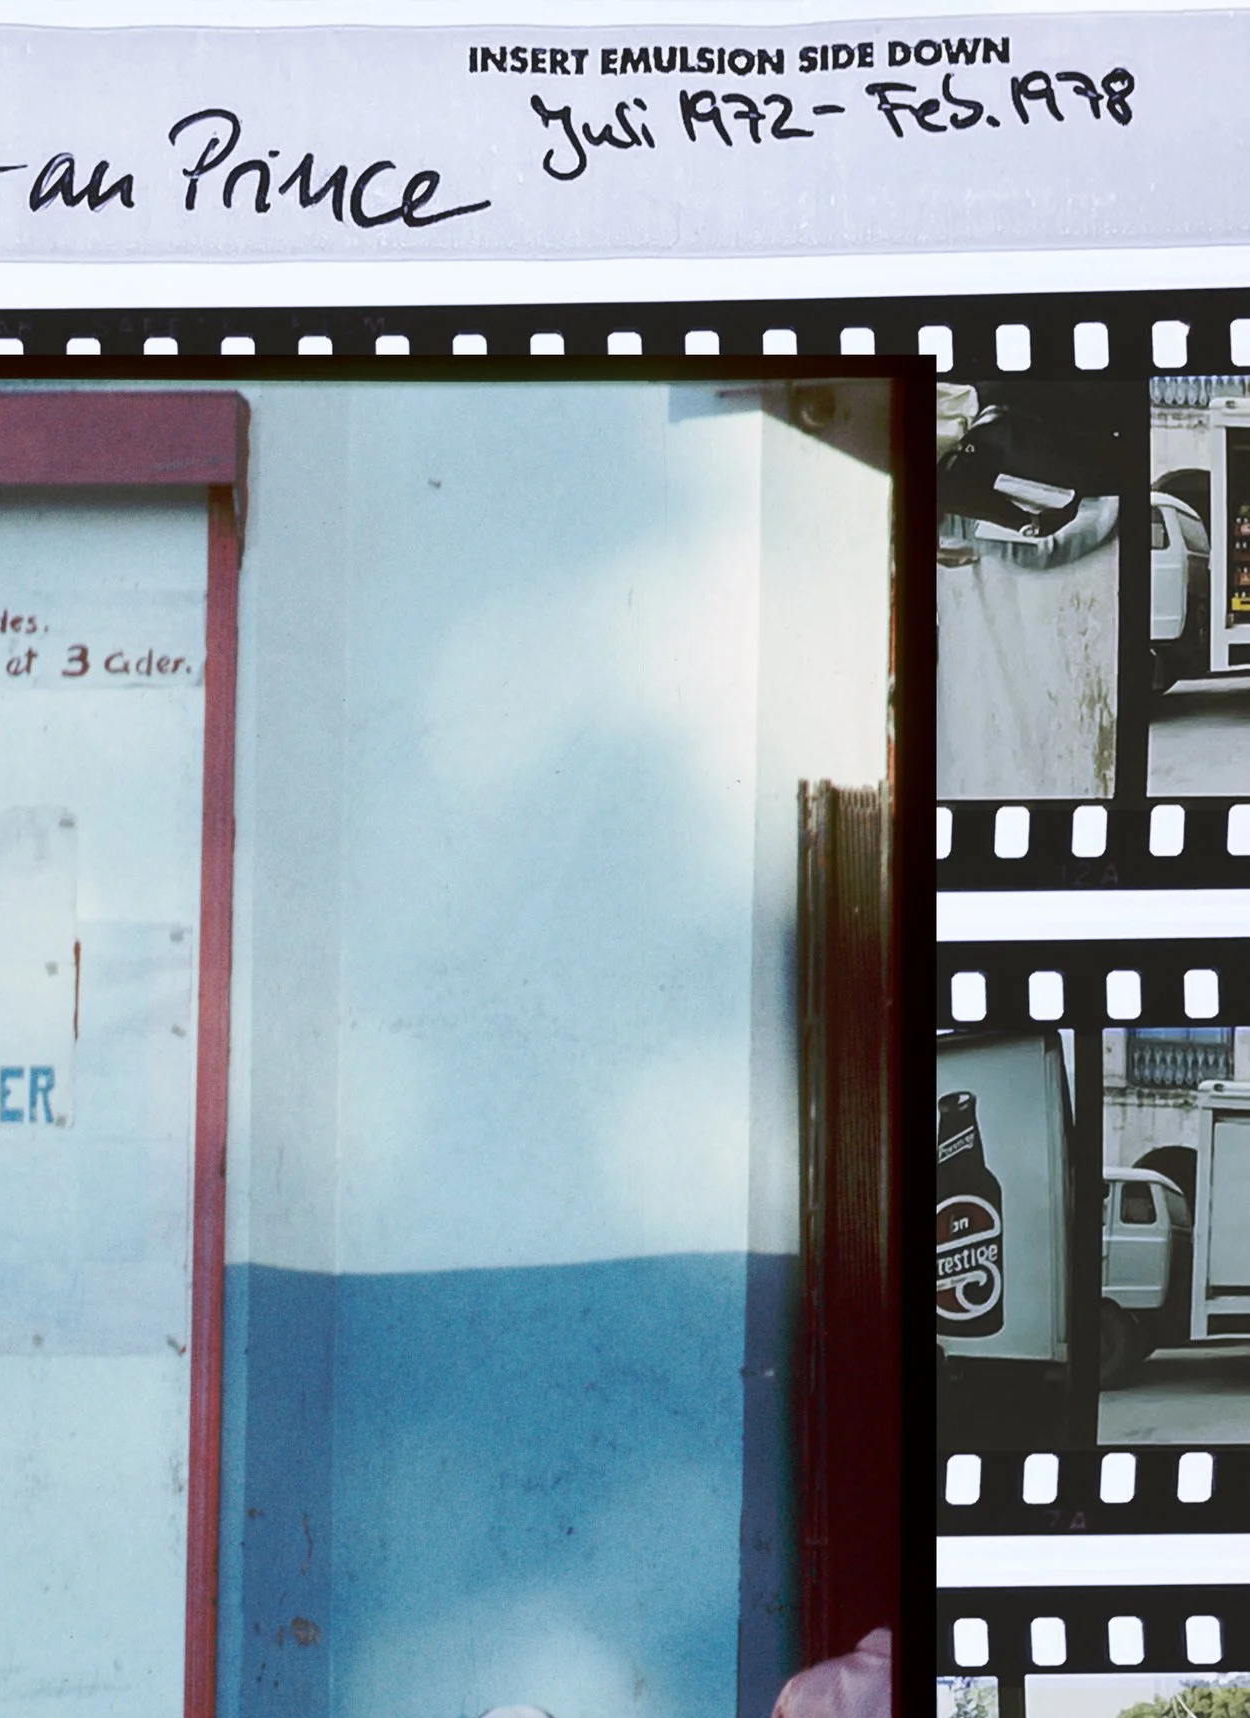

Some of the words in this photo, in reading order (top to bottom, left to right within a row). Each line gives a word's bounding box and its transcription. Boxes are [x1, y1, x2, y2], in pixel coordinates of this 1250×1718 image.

[470, 47, 588, 74] INSERT
[602, 47, 784, 75] EMULSION
[799, 42, 873, 73] SIDE
[888, 38, 1009, 67] DOWN
[865, 74, 1000, 138] Feb.
[1010, 68, 1136, 126] 1978
[166, 107, 492, 230] Prince
[61, 644, 91, 677] 3
[937, 1243, 998, 1277] restige
